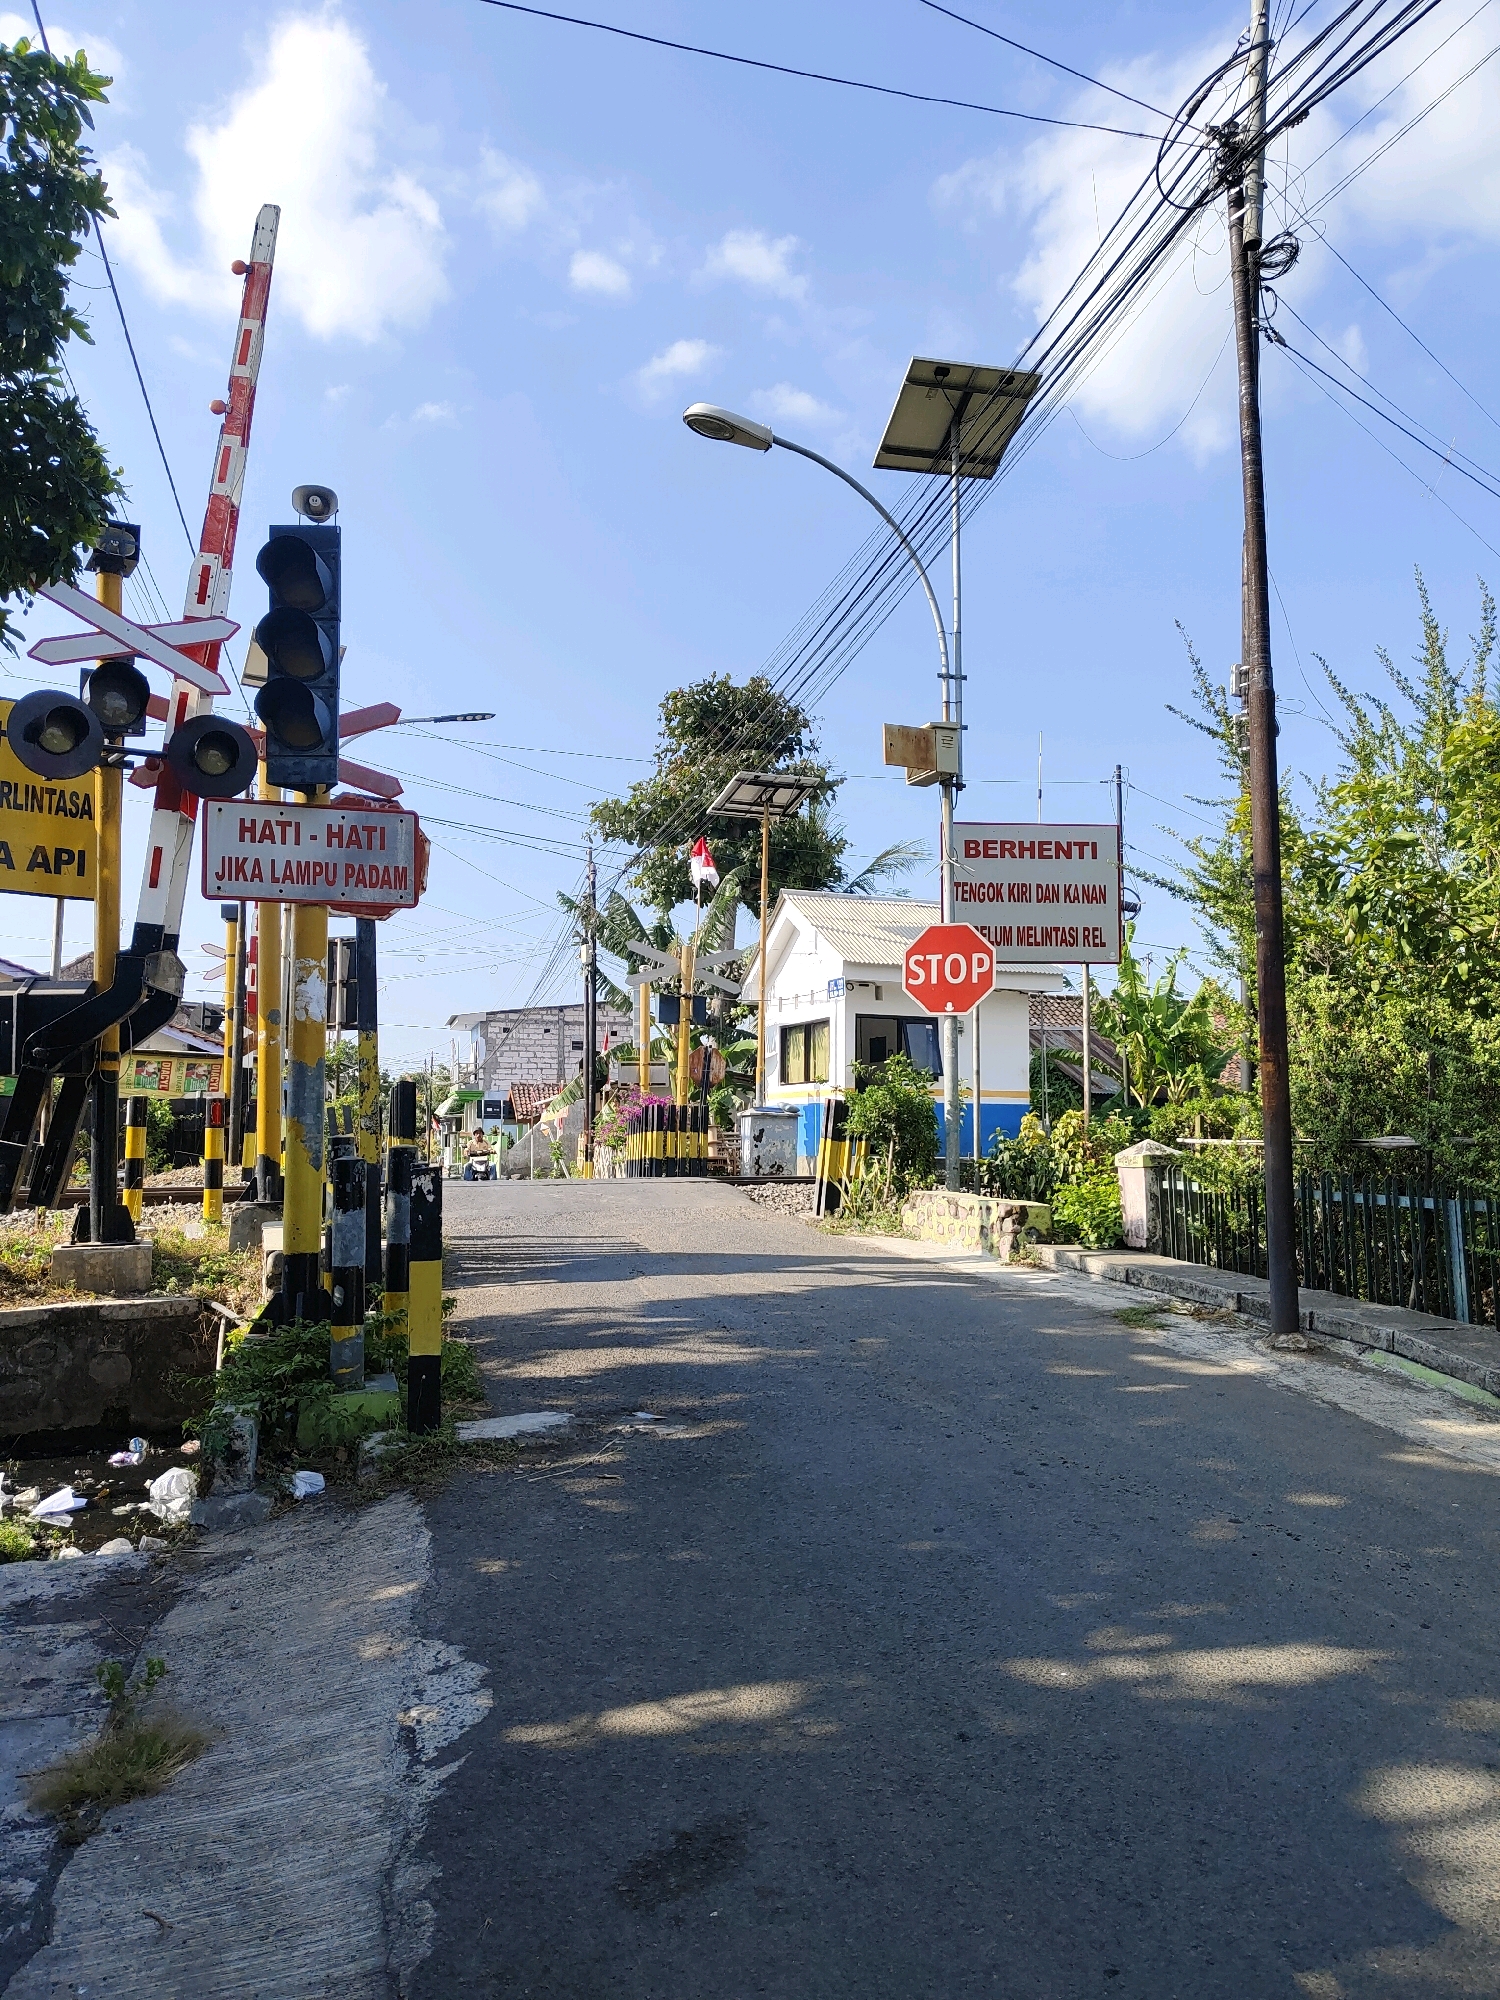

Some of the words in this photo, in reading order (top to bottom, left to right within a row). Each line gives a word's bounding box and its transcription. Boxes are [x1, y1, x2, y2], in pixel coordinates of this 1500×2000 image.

[239, 818, 300, 845] HATI
[326, 824, 386, 850] HATI
[964, 839, 1098, 860] BERHENTI
[26, 844, 86, 877] API
[215, 856, 263, 882] JIKA
[271, 858, 337, 886] LAMPU
[345, 862, 408, 890] PADAM
[954, 882, 1005, 903] TENGOK
[1008, 882, 1032, 903] KIRI
[1036, 883, 1060, 903] DAN
[1063, 884, 1107, 905] KANAN
[1016, 926, 1079, 947] MELINTASI
[1082, 926, 1107, 948] REL
[907, 953, 991, 985] STOP
